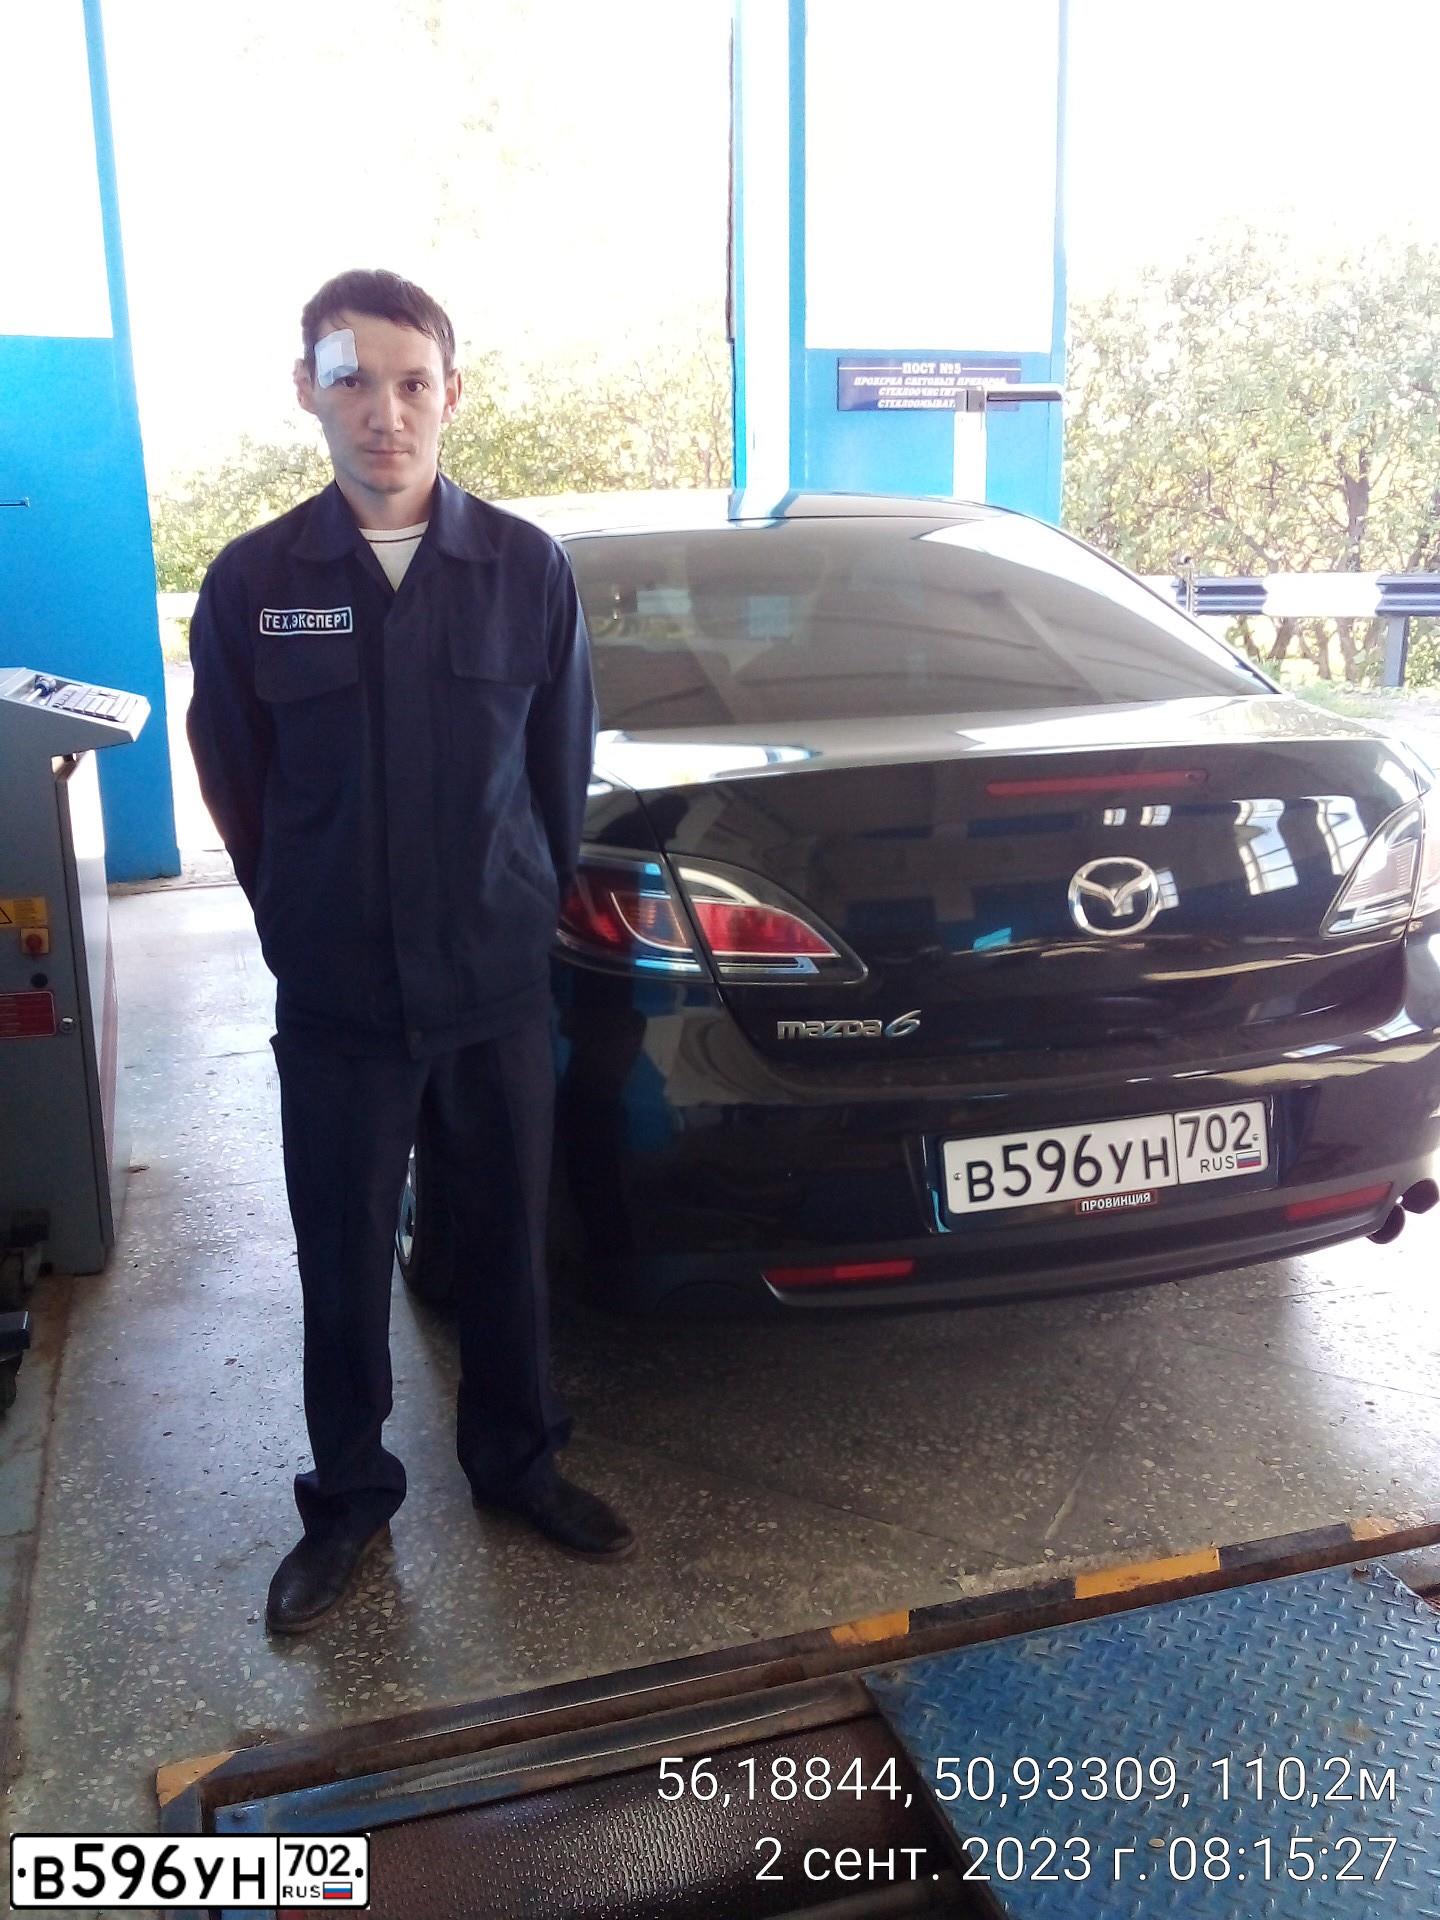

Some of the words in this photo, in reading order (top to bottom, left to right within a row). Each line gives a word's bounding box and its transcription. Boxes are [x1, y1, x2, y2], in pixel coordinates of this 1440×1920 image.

[902, 363, 936, 374] ПОСТ
[966, 1133, 1170, 1203] В596УН
[1179, 1111, 1253, 1158] 702
[1200, 1155, 1235, 1173] RUS
[1081, 1192, 1151, 1212] ПРОВИНЦИЯ
